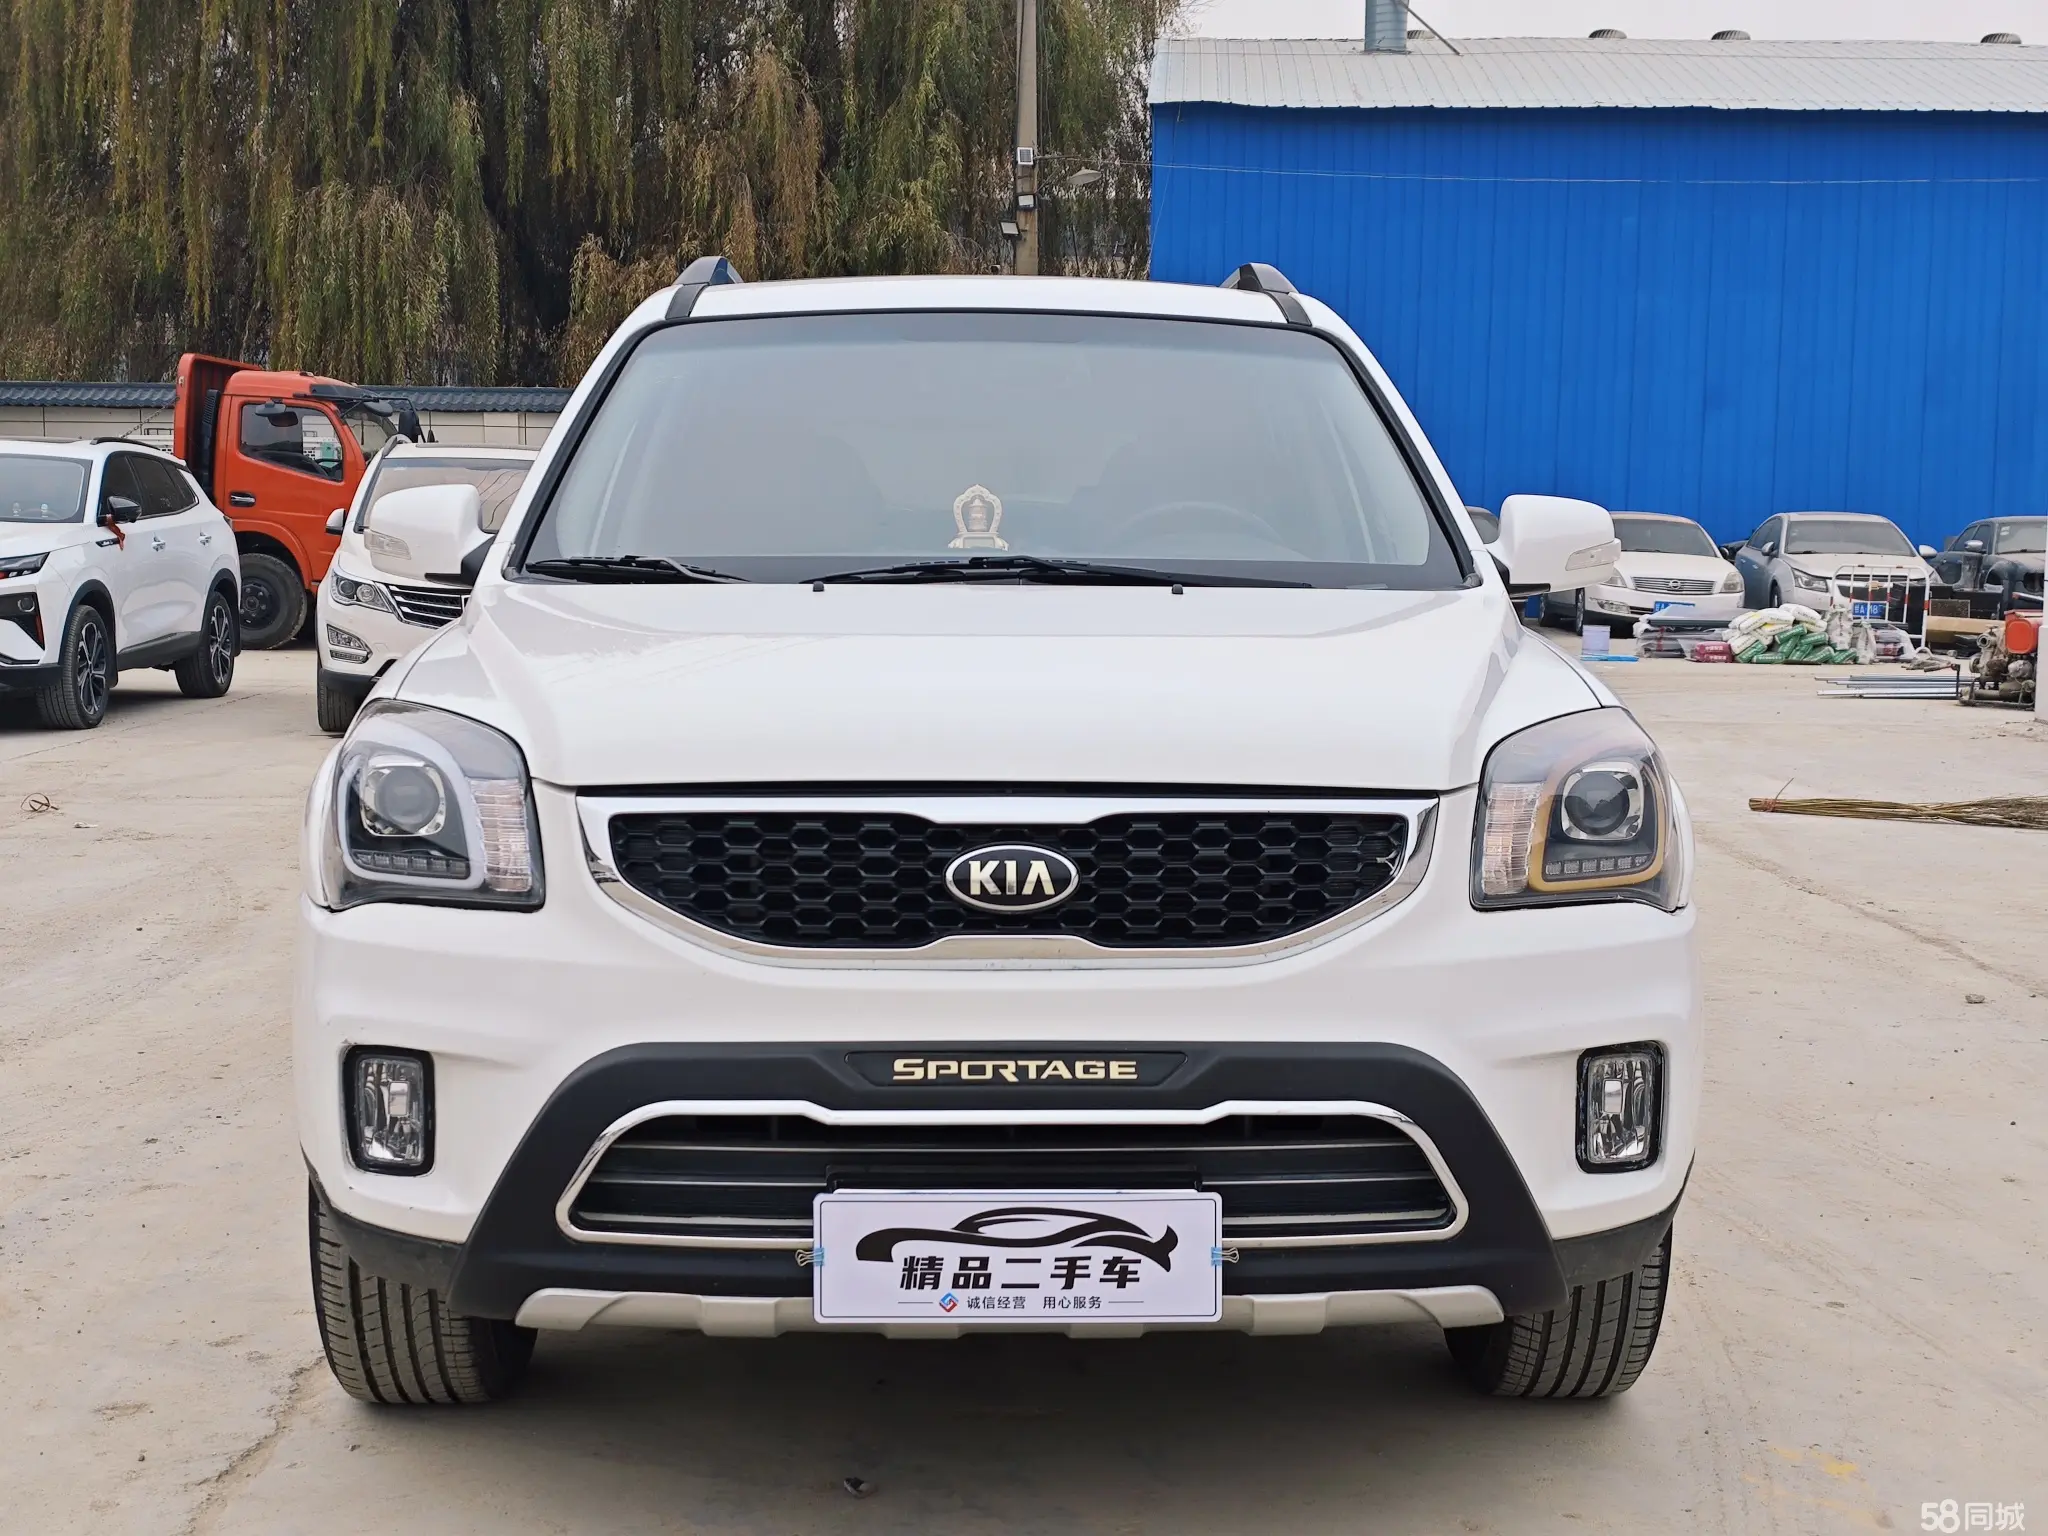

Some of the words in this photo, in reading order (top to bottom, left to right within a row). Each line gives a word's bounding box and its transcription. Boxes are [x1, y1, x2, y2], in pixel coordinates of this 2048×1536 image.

[968, 860, 1056, 896] KIA
[892, 1058, 1139, 1083] SPORTAGE
[899, 1254, 1142, 1291] 精品二手车
[966, 1295, 1027, 1310] 诚信经营
[1042, 1295, 1103, 1310] 用心服务
